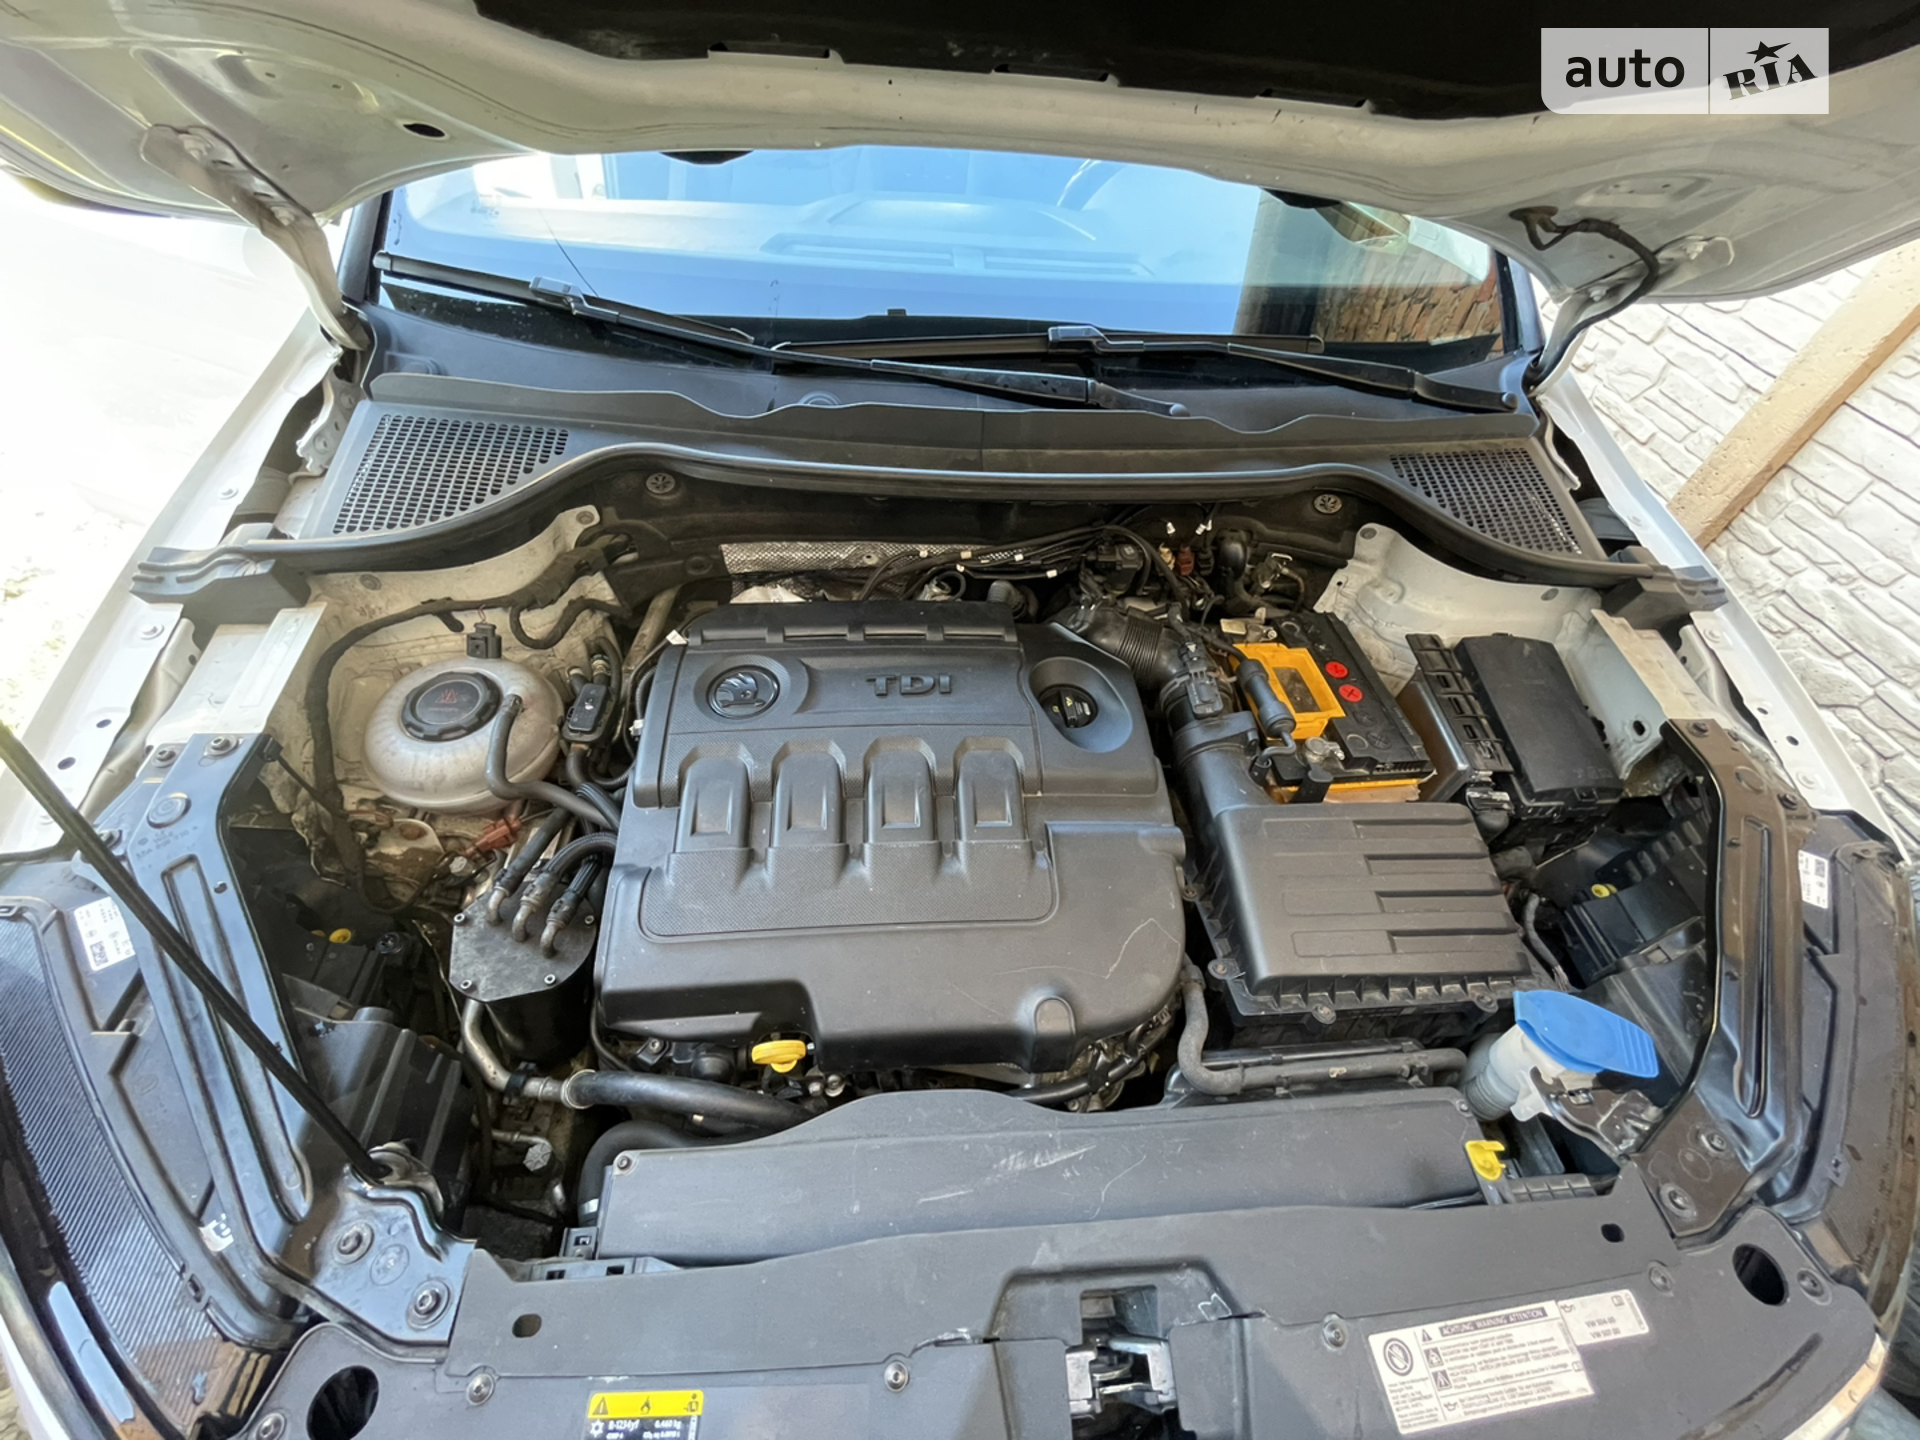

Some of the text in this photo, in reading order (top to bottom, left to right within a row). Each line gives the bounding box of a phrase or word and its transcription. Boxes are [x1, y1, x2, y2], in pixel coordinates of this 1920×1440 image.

[866, 674, 952, 697] TDI
[1442, 1308, 1545, 1336] ACHTUNG WARNING ATTENTION
[1585, 1320, 1597, 1328] VW
[1590, 1331, 1602, 1340] VW
